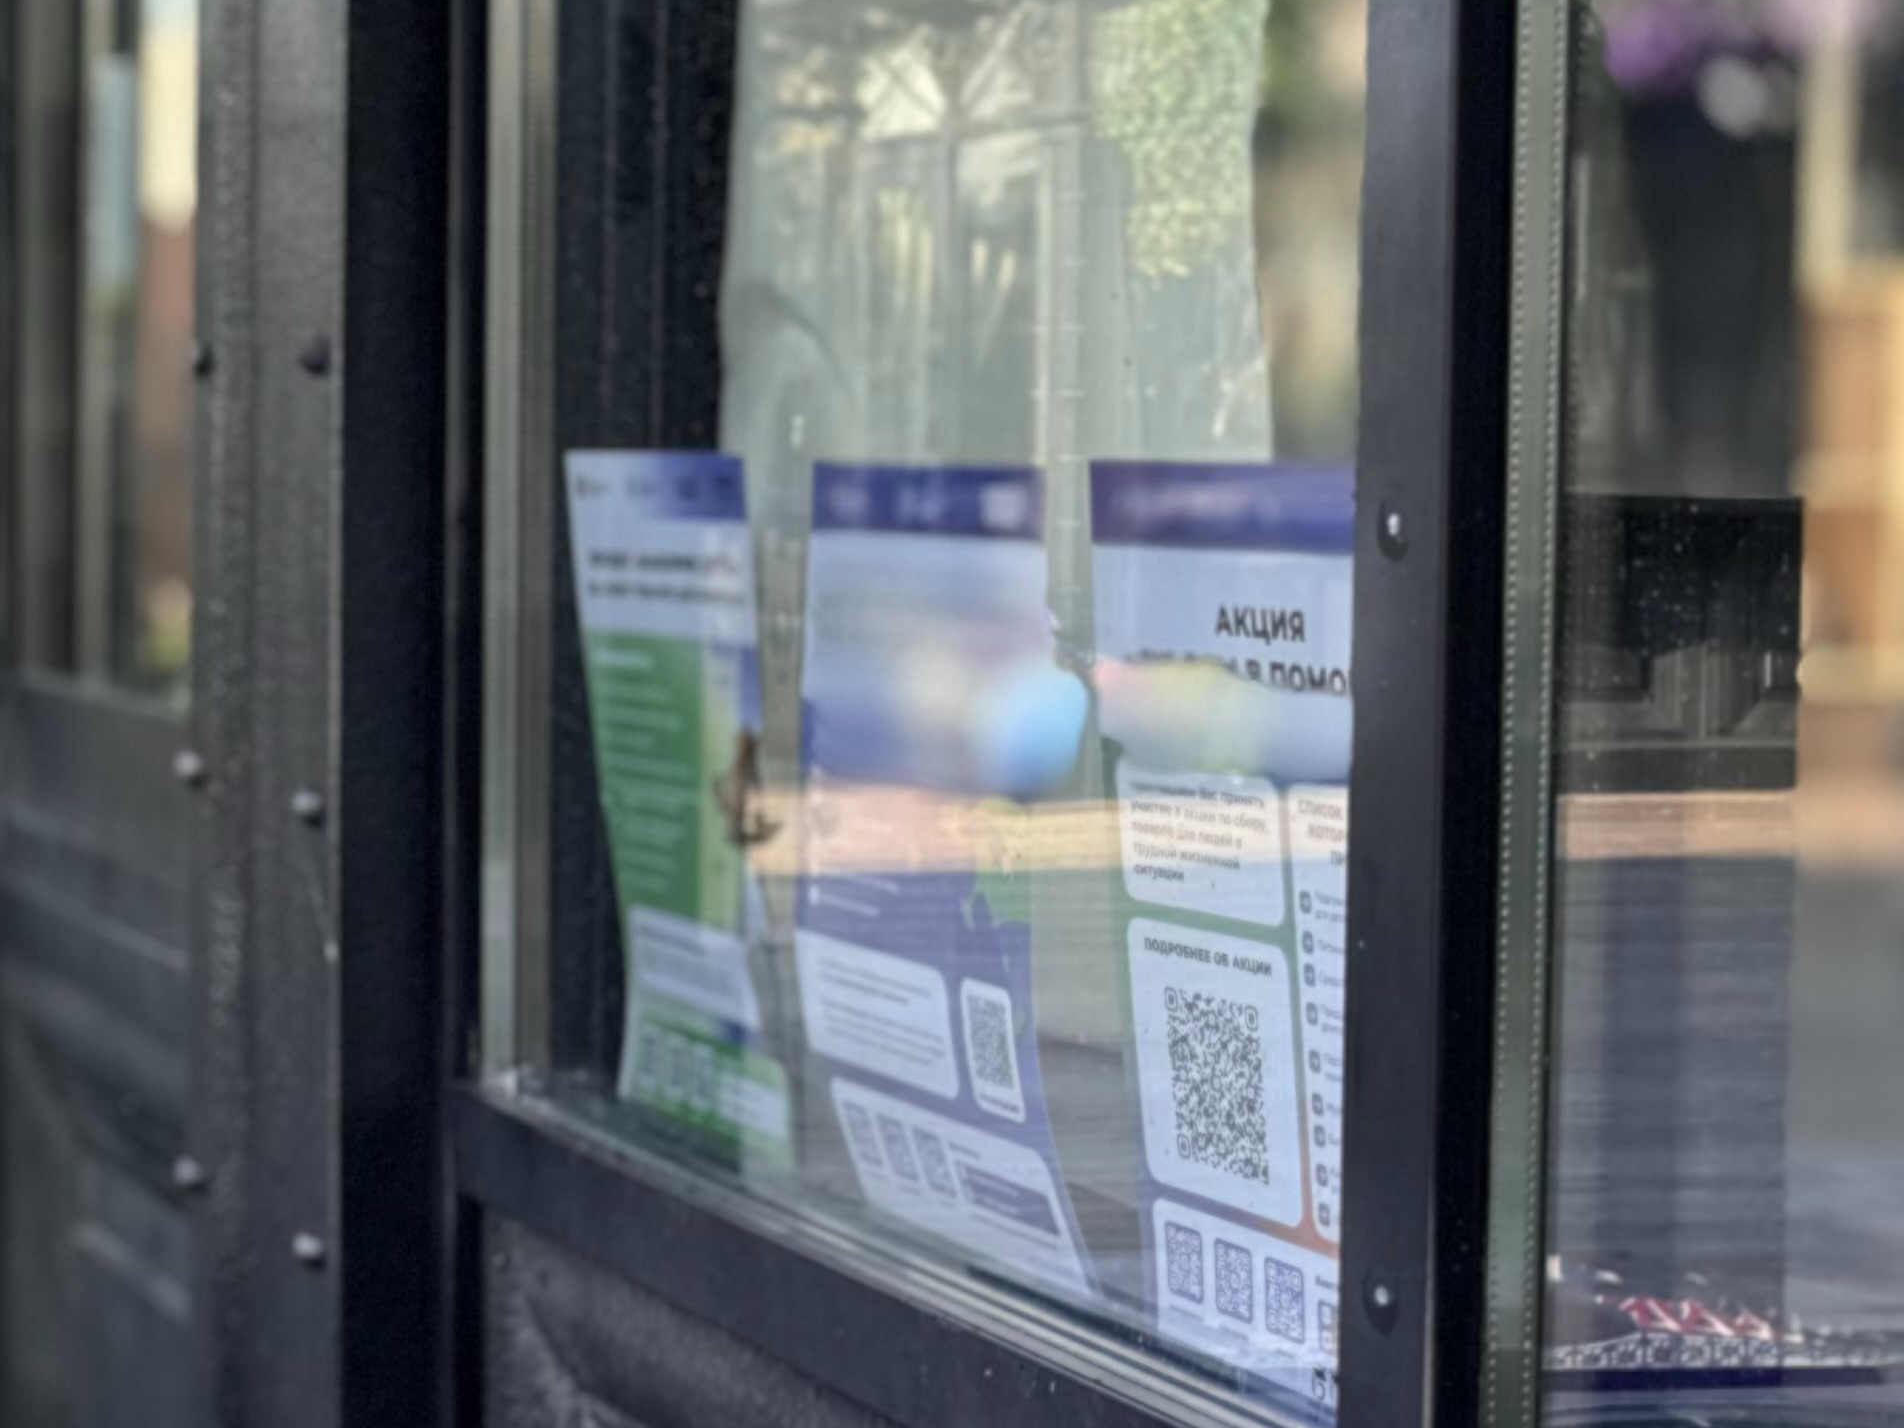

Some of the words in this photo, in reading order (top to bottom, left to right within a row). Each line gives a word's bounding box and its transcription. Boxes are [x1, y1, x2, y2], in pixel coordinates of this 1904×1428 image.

[1215, 605, 1306, 645] АКЦИЯ
[1144, 937, 1211, 964] ПОДРОБНЕЕ
[1214, 951, 1230, 967] ОБ
[1232, 955, 1272, 977] АКЦИИ
